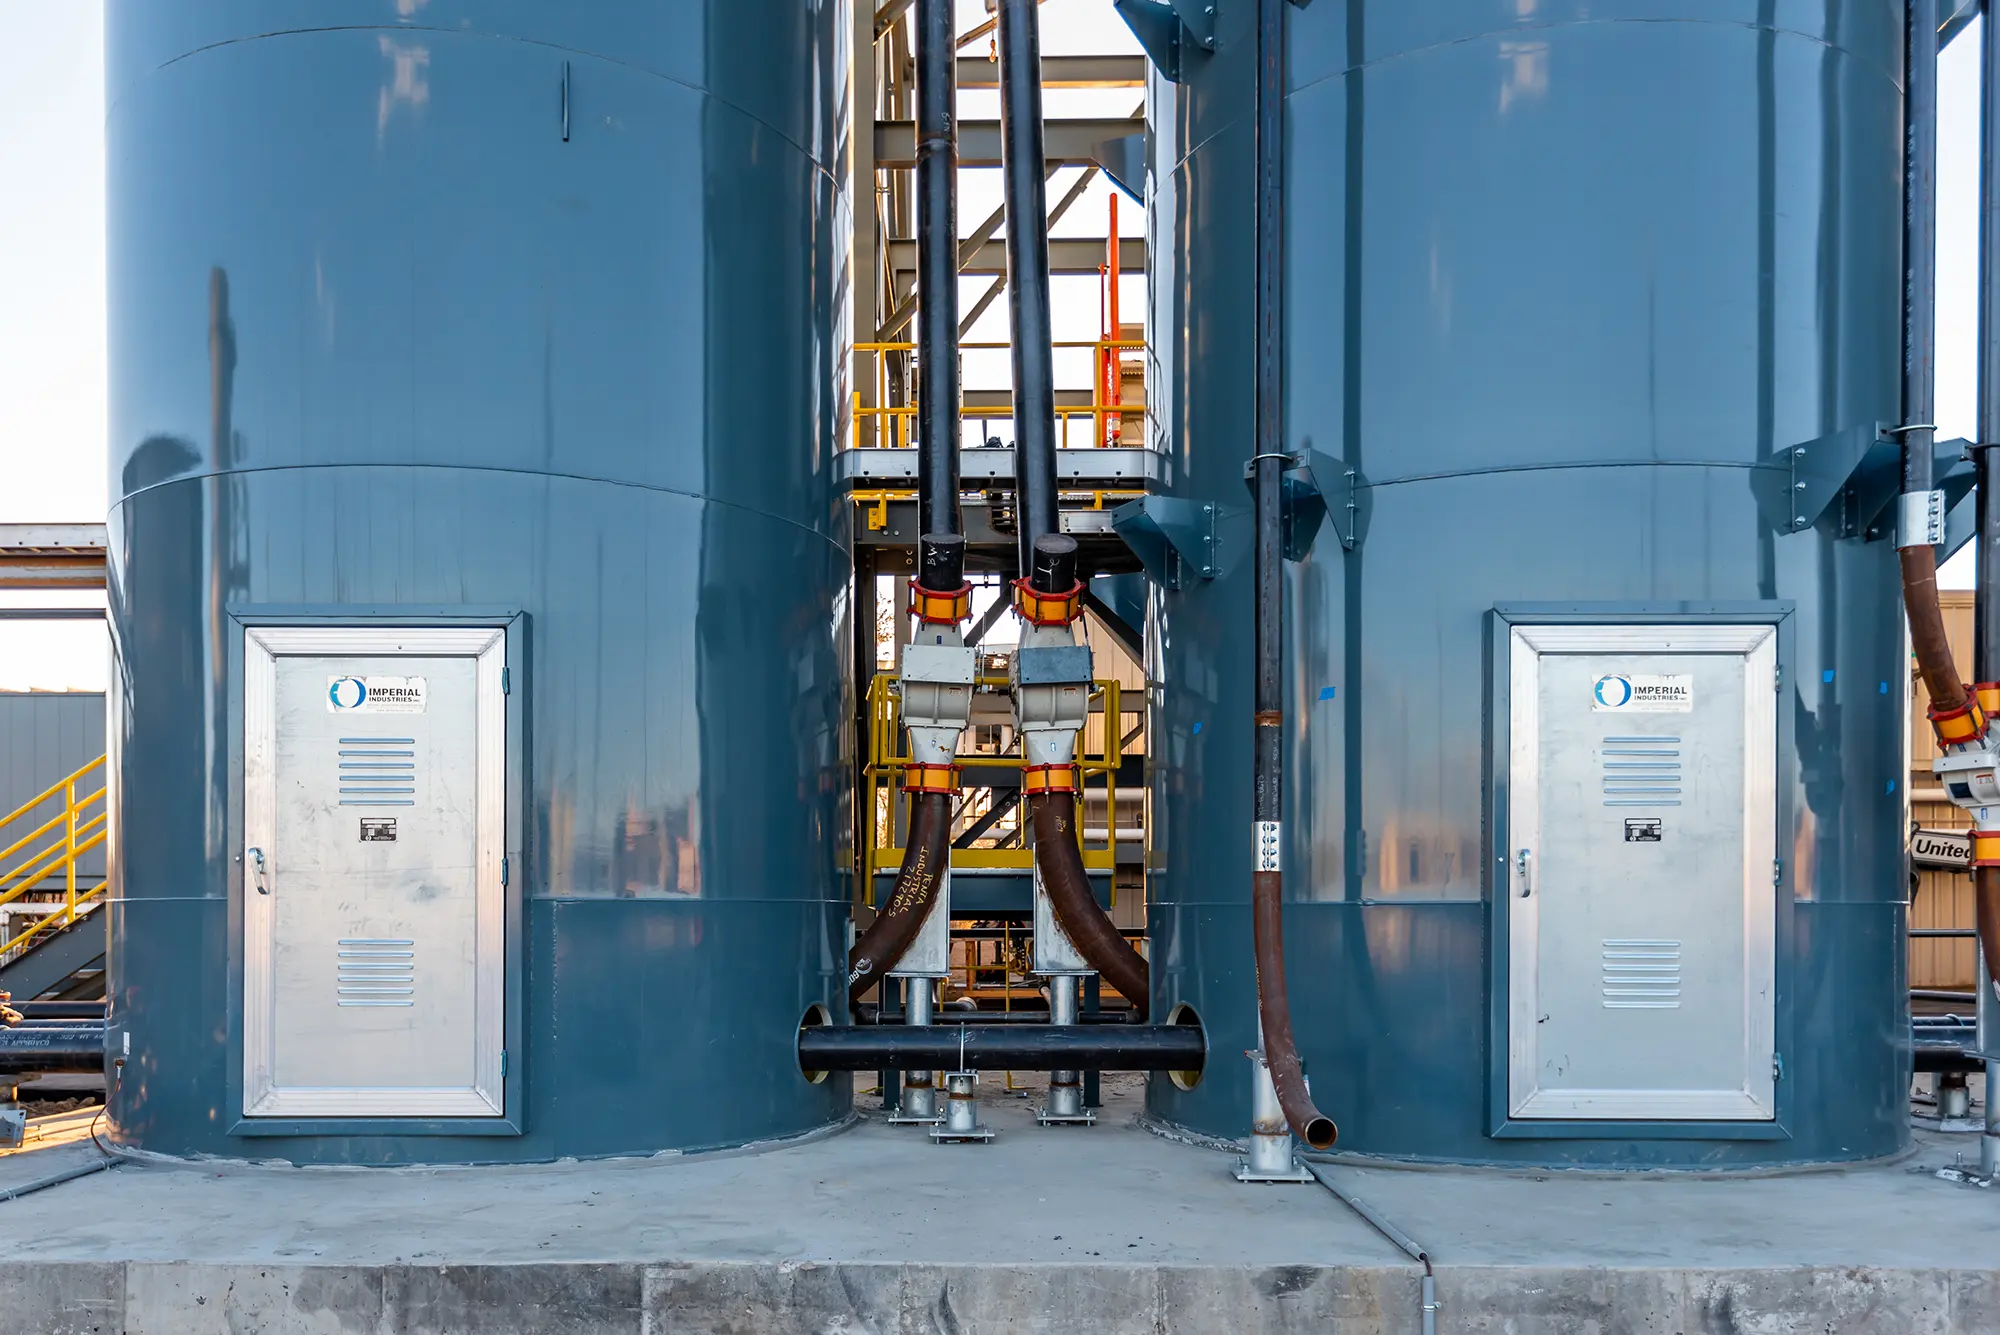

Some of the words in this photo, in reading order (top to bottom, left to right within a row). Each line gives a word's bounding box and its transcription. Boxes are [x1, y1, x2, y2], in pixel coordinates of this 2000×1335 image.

[369, 688, 421, 696] IMPERIAL
[1634, 686, 1687, 694] IMPERIAL
[900, 845, 929, 913] INDUSTRIAL
[916, 873, 933, 904] PENTA
